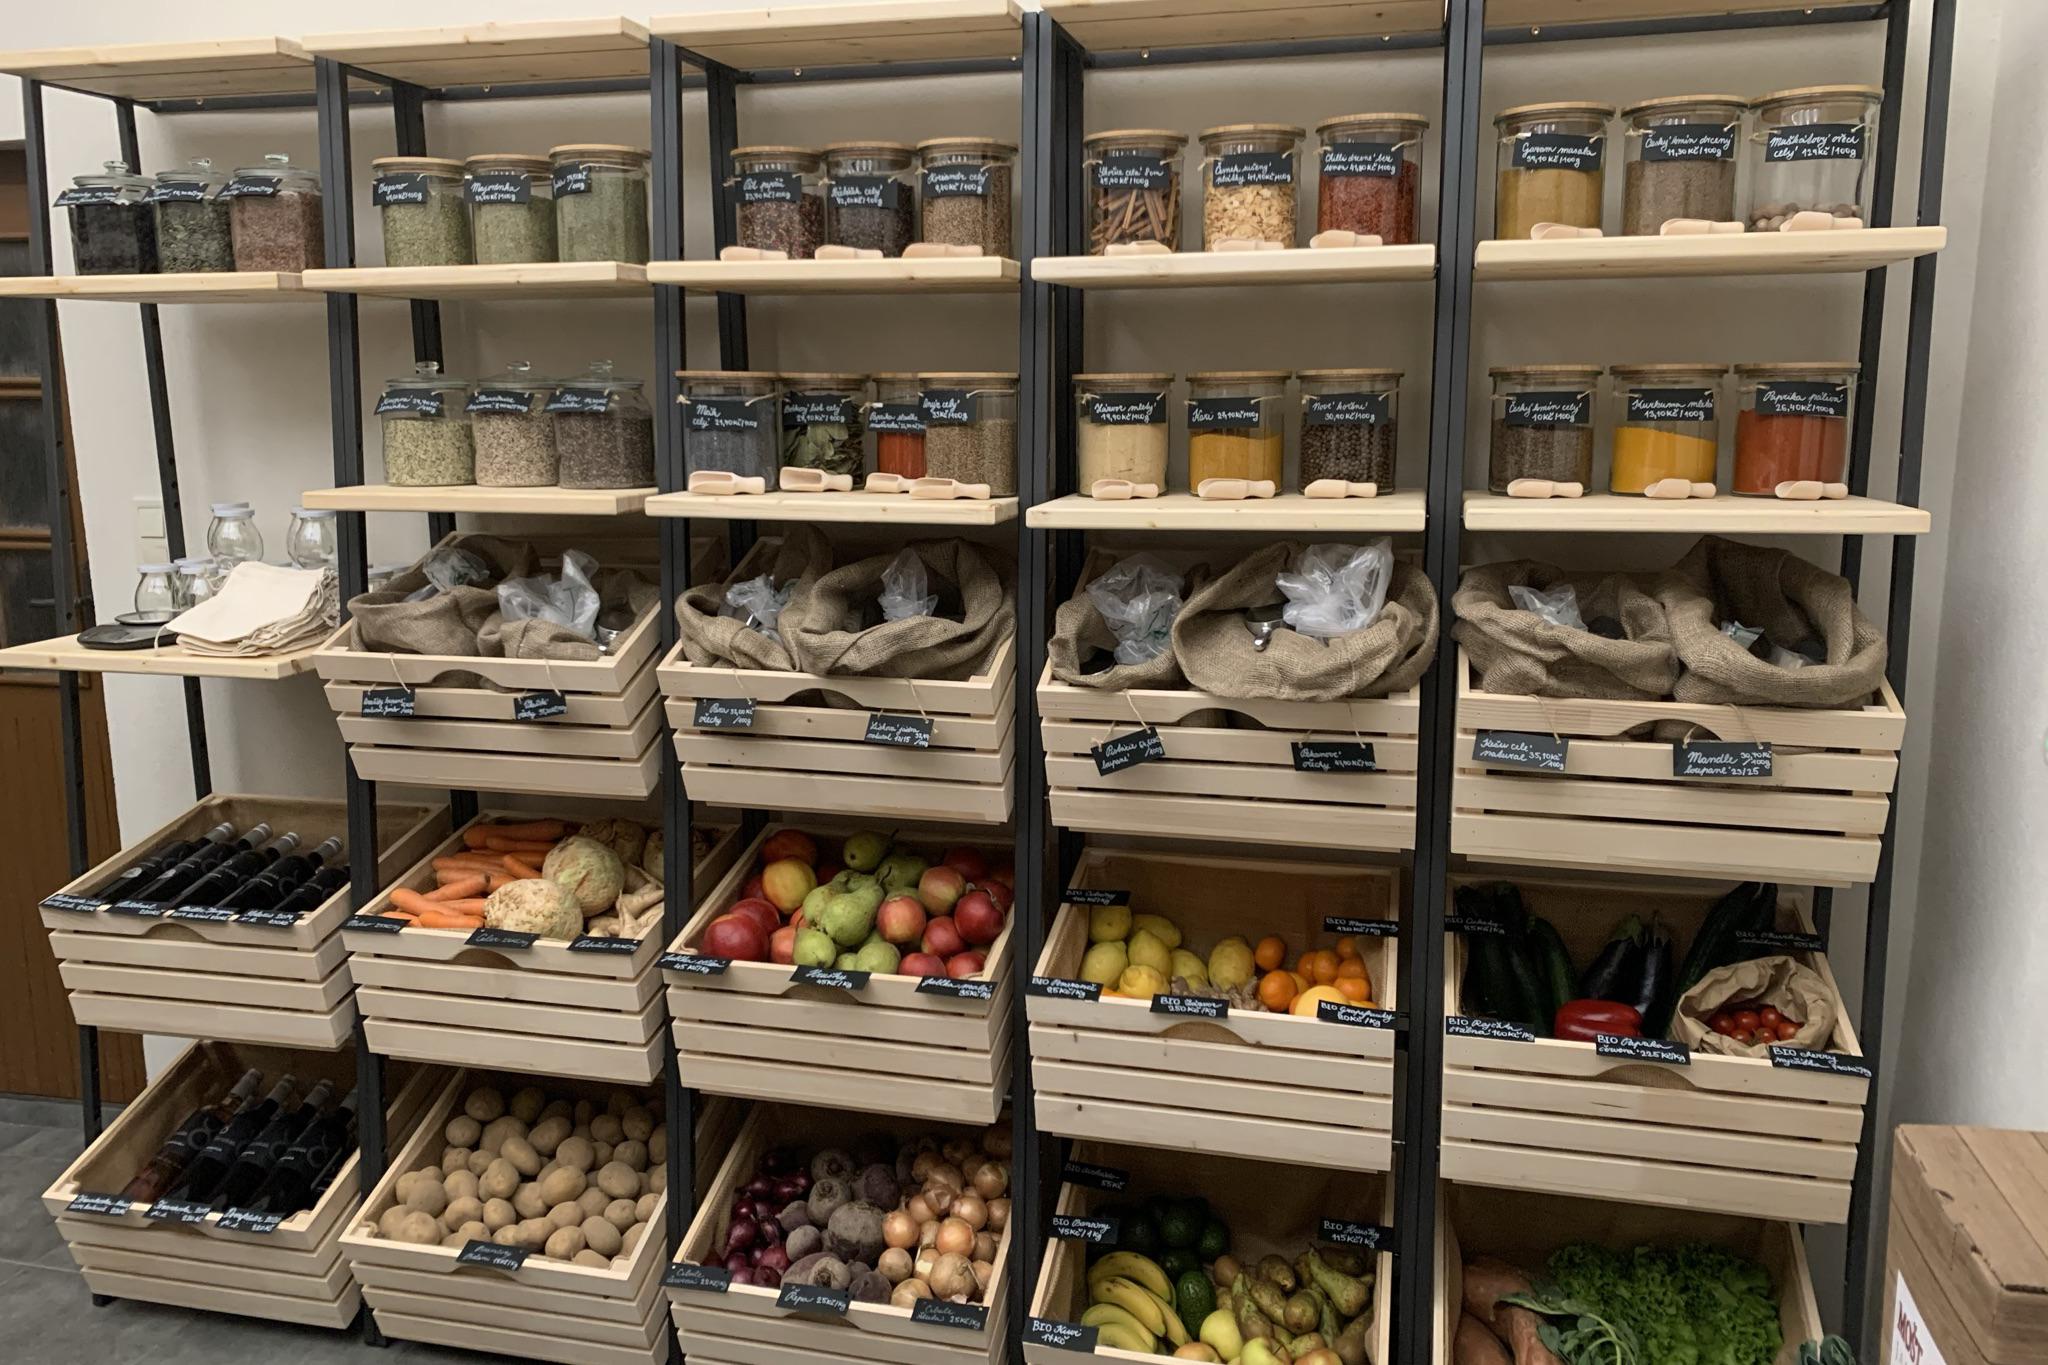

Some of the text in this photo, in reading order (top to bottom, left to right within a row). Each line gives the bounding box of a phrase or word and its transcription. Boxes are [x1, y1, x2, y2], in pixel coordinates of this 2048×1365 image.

[1769, 133, 1830, 149] Muškátový
[1521, 142, 1556, 158] Garam
[1773, 146, 1797, 160] celý
[1762, 390, 1806, 404] Paprika
[1687, 751, 1738, 764] Mandle
[1160, 996, 1181, 1005] BIO
[1320, 1002, 1338, 1011] BIO
[1448, 1017, 1469, 1026] BIO
[1597, 1034, 1619, 1044] BIO
[1772, 1046, 1797, 1057] BIO
[1052, 1217, 1070, 1226] BIO
[1323, 1220, 1343, 1231] BIO
[1032, 1319, 1082, 1337] BIO Kiwi
